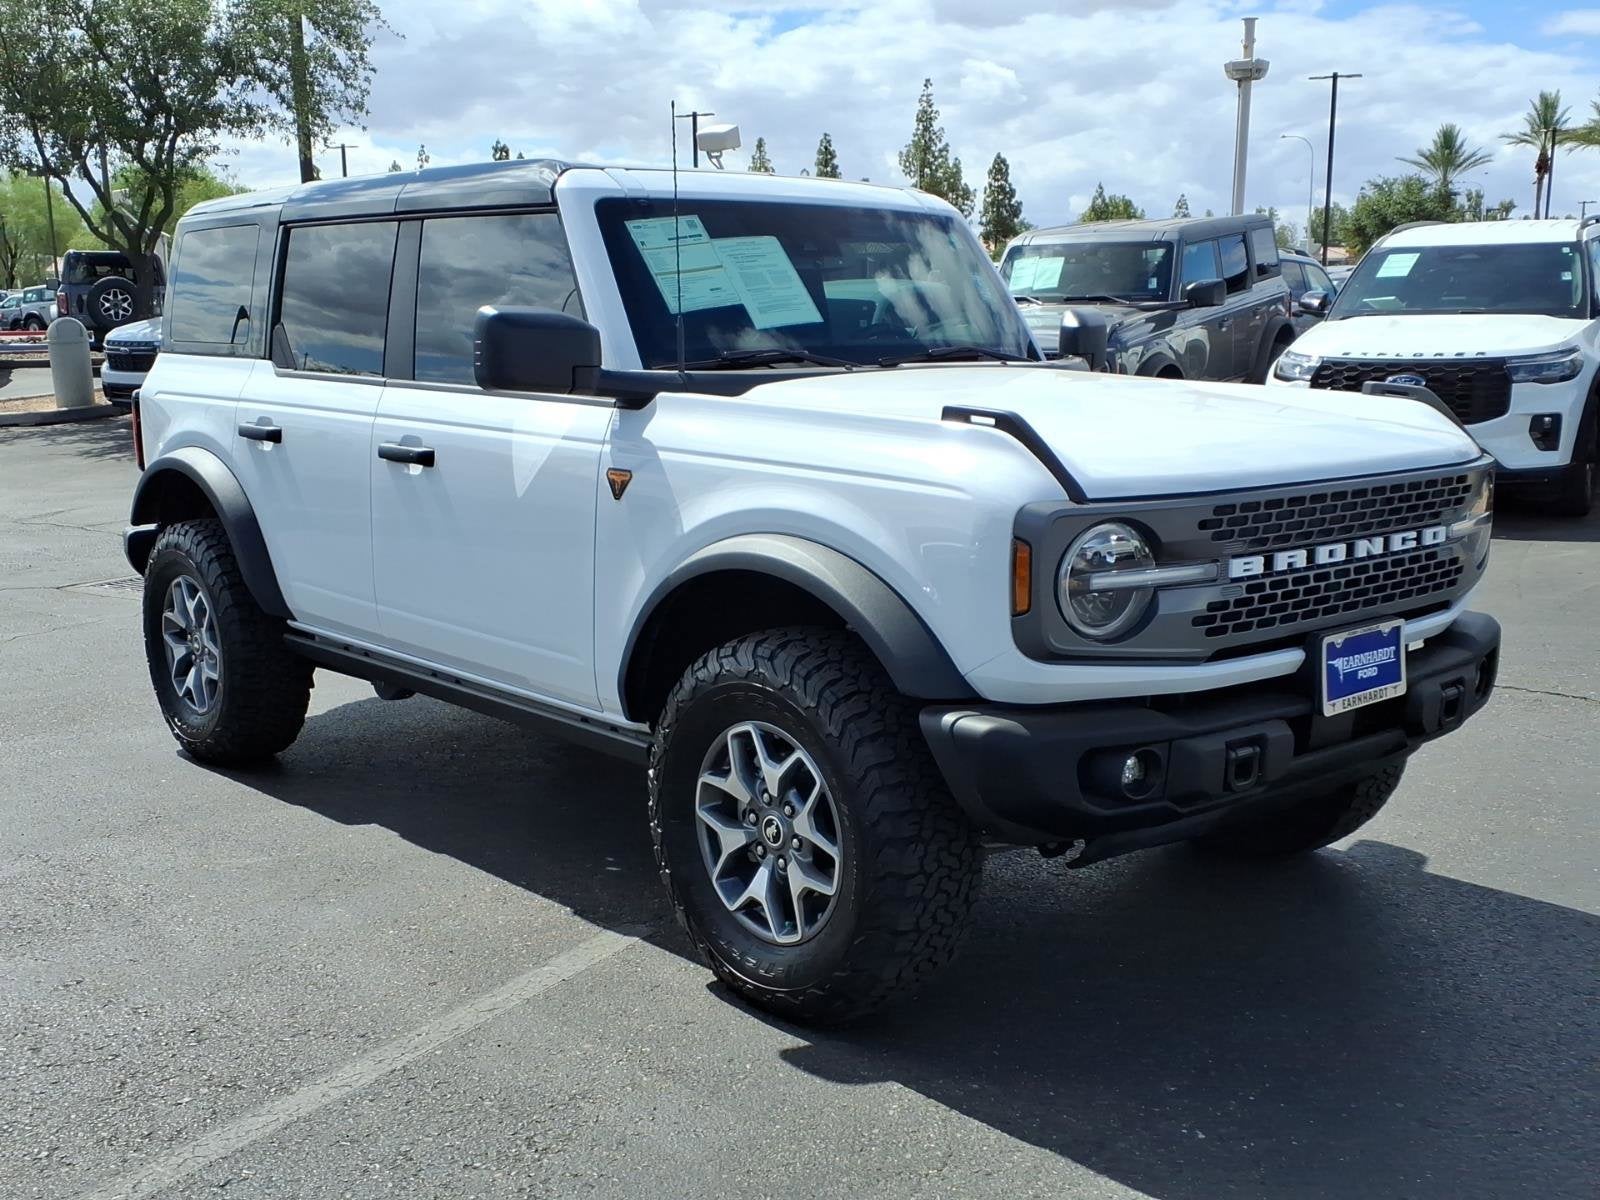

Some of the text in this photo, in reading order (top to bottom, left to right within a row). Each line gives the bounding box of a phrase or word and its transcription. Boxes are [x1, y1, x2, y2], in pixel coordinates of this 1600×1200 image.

[1228, 525, 1447, 579] BRONCO
[1343, 646, 1396, 669] EARNHARDT
[1357, 666, 1378, 680] FORD
[1342, 687, 1389, 709] EARNHARDT
